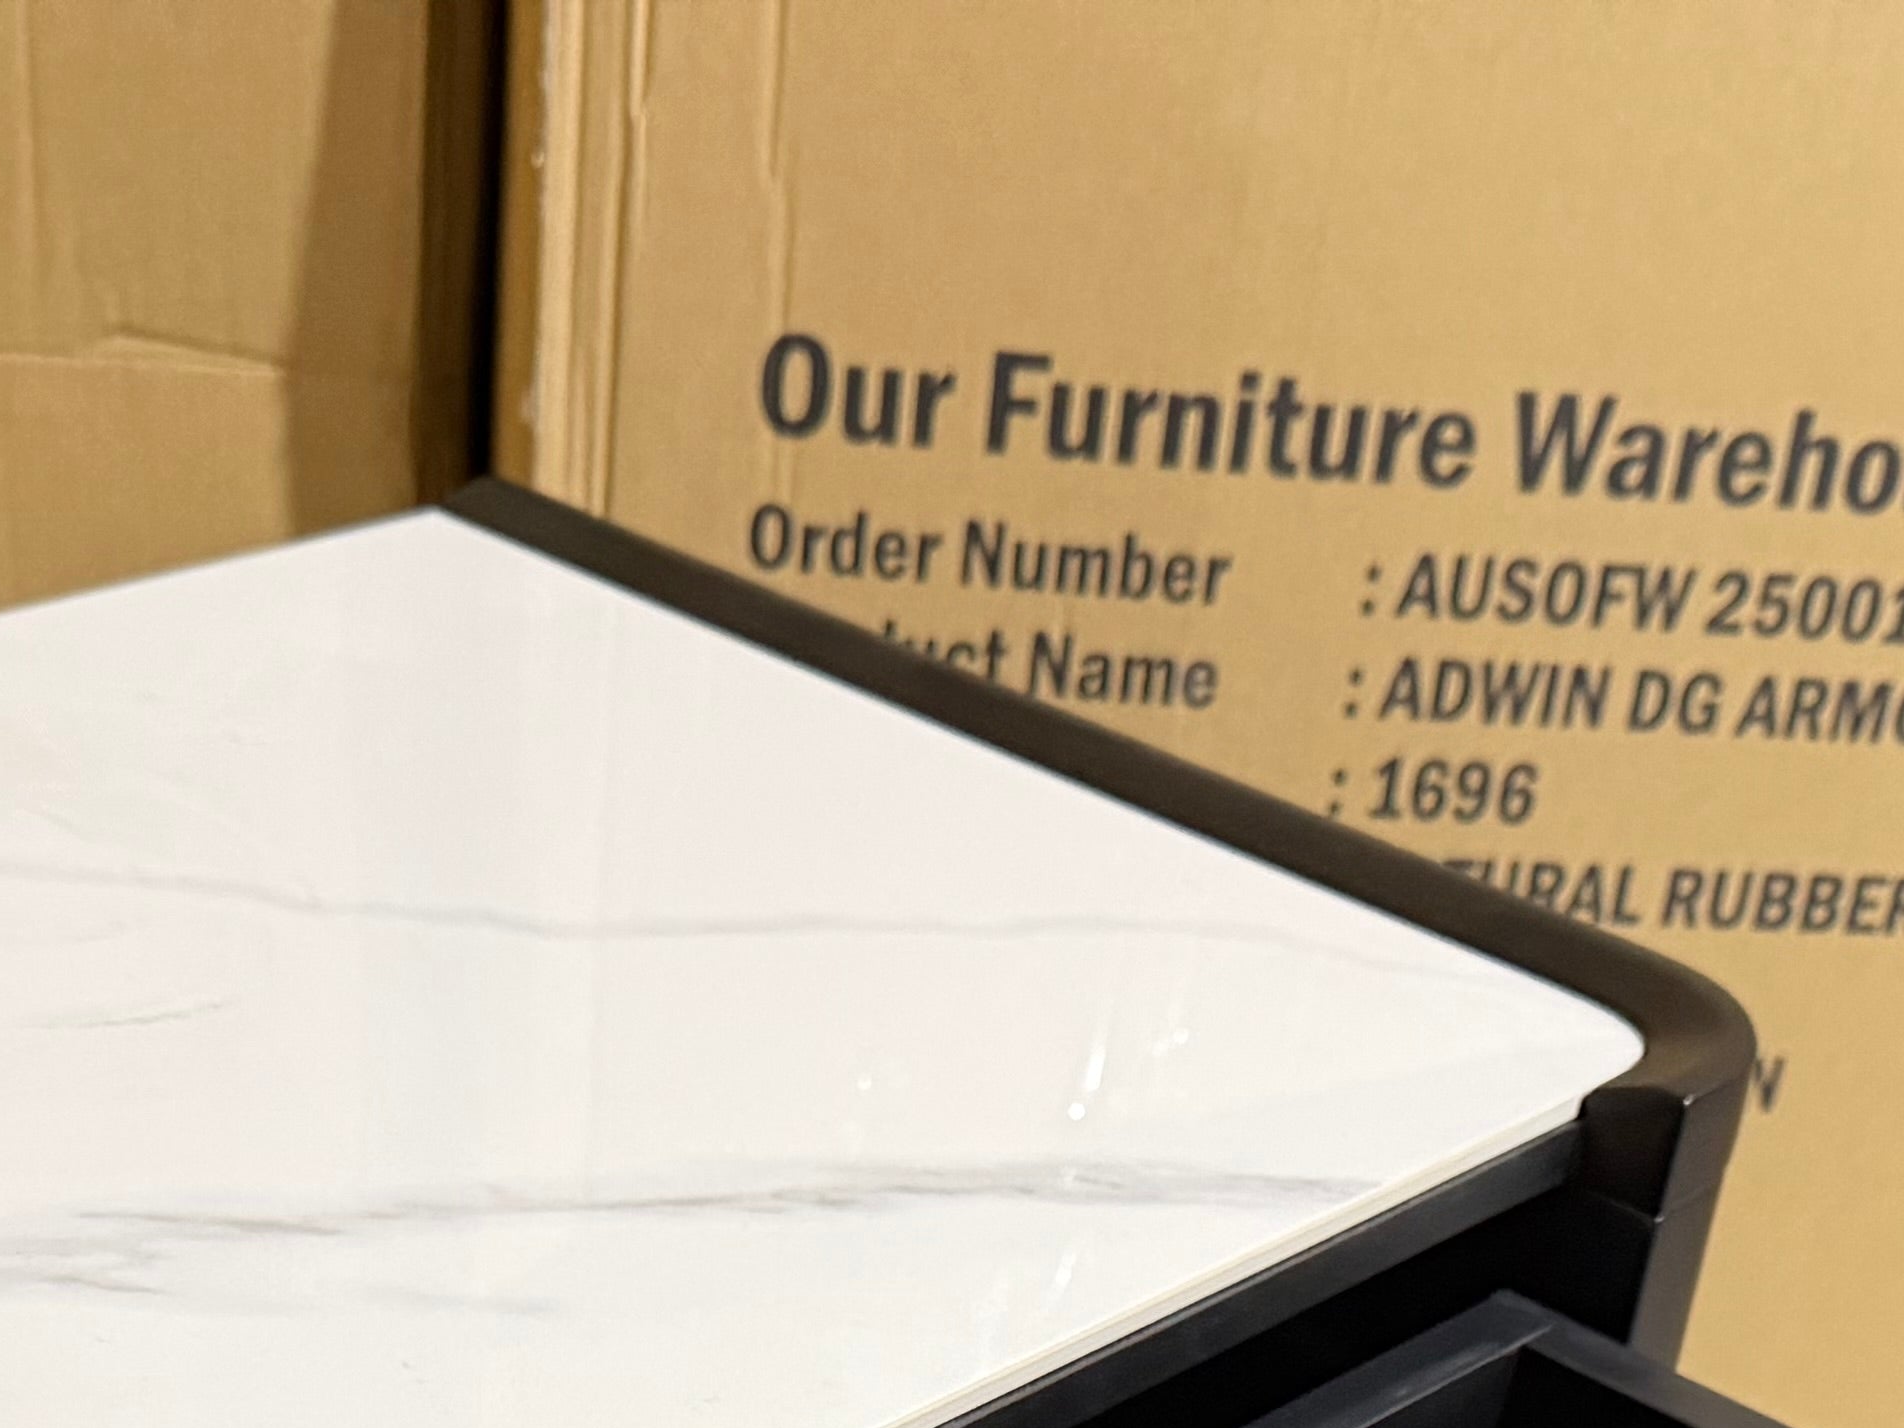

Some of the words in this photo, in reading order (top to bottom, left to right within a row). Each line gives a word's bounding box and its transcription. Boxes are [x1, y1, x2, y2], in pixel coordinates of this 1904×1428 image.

[760, 332, 955, 449] Our
[985, 351, 1475, 489] Furniture
[748, 503, 942, 582] Order
[960, 519, 1233, 606] Number
[1396, 554, 1698, 633] AUSOFW
[1027, 631, 1218, 711] Name
[1379, 657, 1612, 730] ADWIN
[1626, 668, 1723, 737] DG
[1368, 759, 1539, 826] 1696
